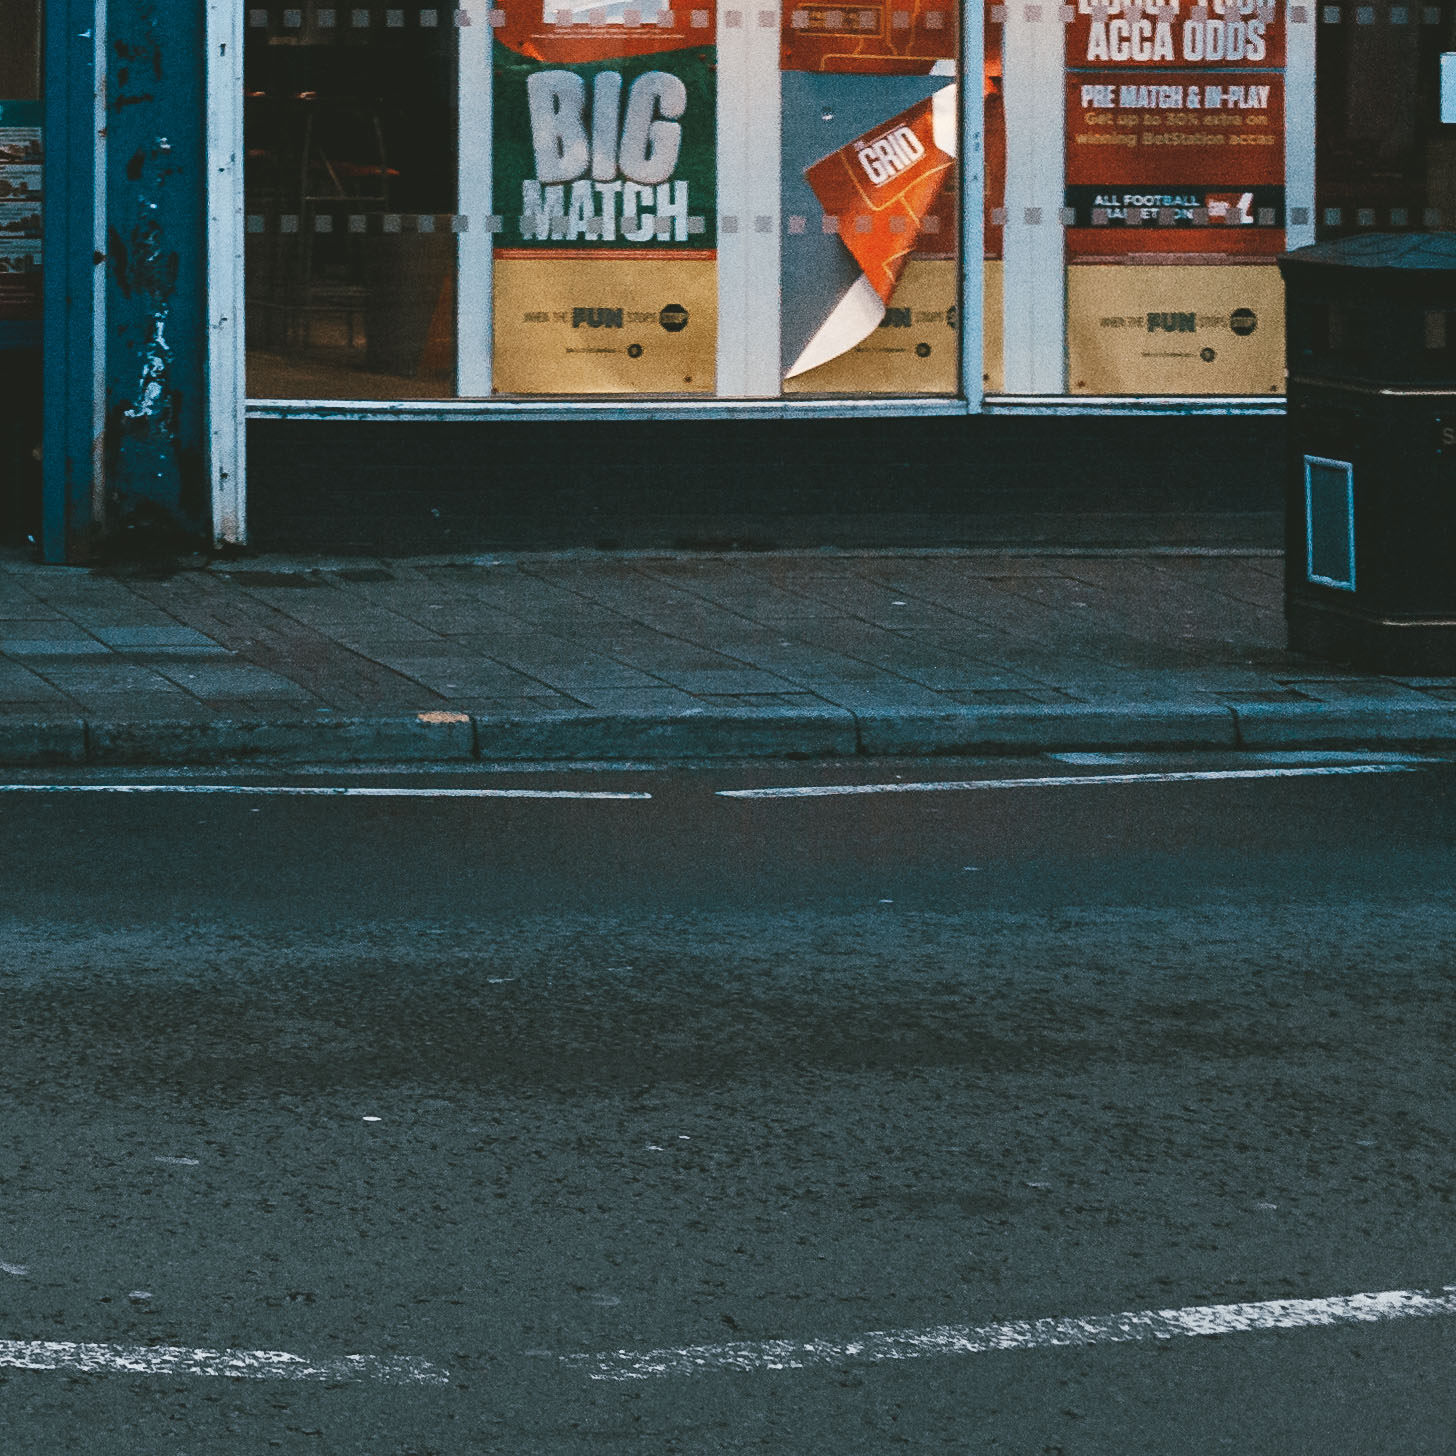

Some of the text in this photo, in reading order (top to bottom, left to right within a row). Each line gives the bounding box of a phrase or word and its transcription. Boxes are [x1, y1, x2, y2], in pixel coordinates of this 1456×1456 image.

[1087, 19, 1267, 62] ACCA ODDS
[1081, 85, 1116, 109] PRE
[1119, 85, 1184, 109] MATCH
[1204, 85, 1270, 109] IN-PLAY
[527, 70, 688, 185] BIG
[858, 126, 925, 185] GRID
[522, 179, 689, 242] MATCH
[1093, 195, 1202, 207] ALL FOOTBALL
[572, 307, 624, 329] FUN
[1146, 312, 1197, 333] FUN
